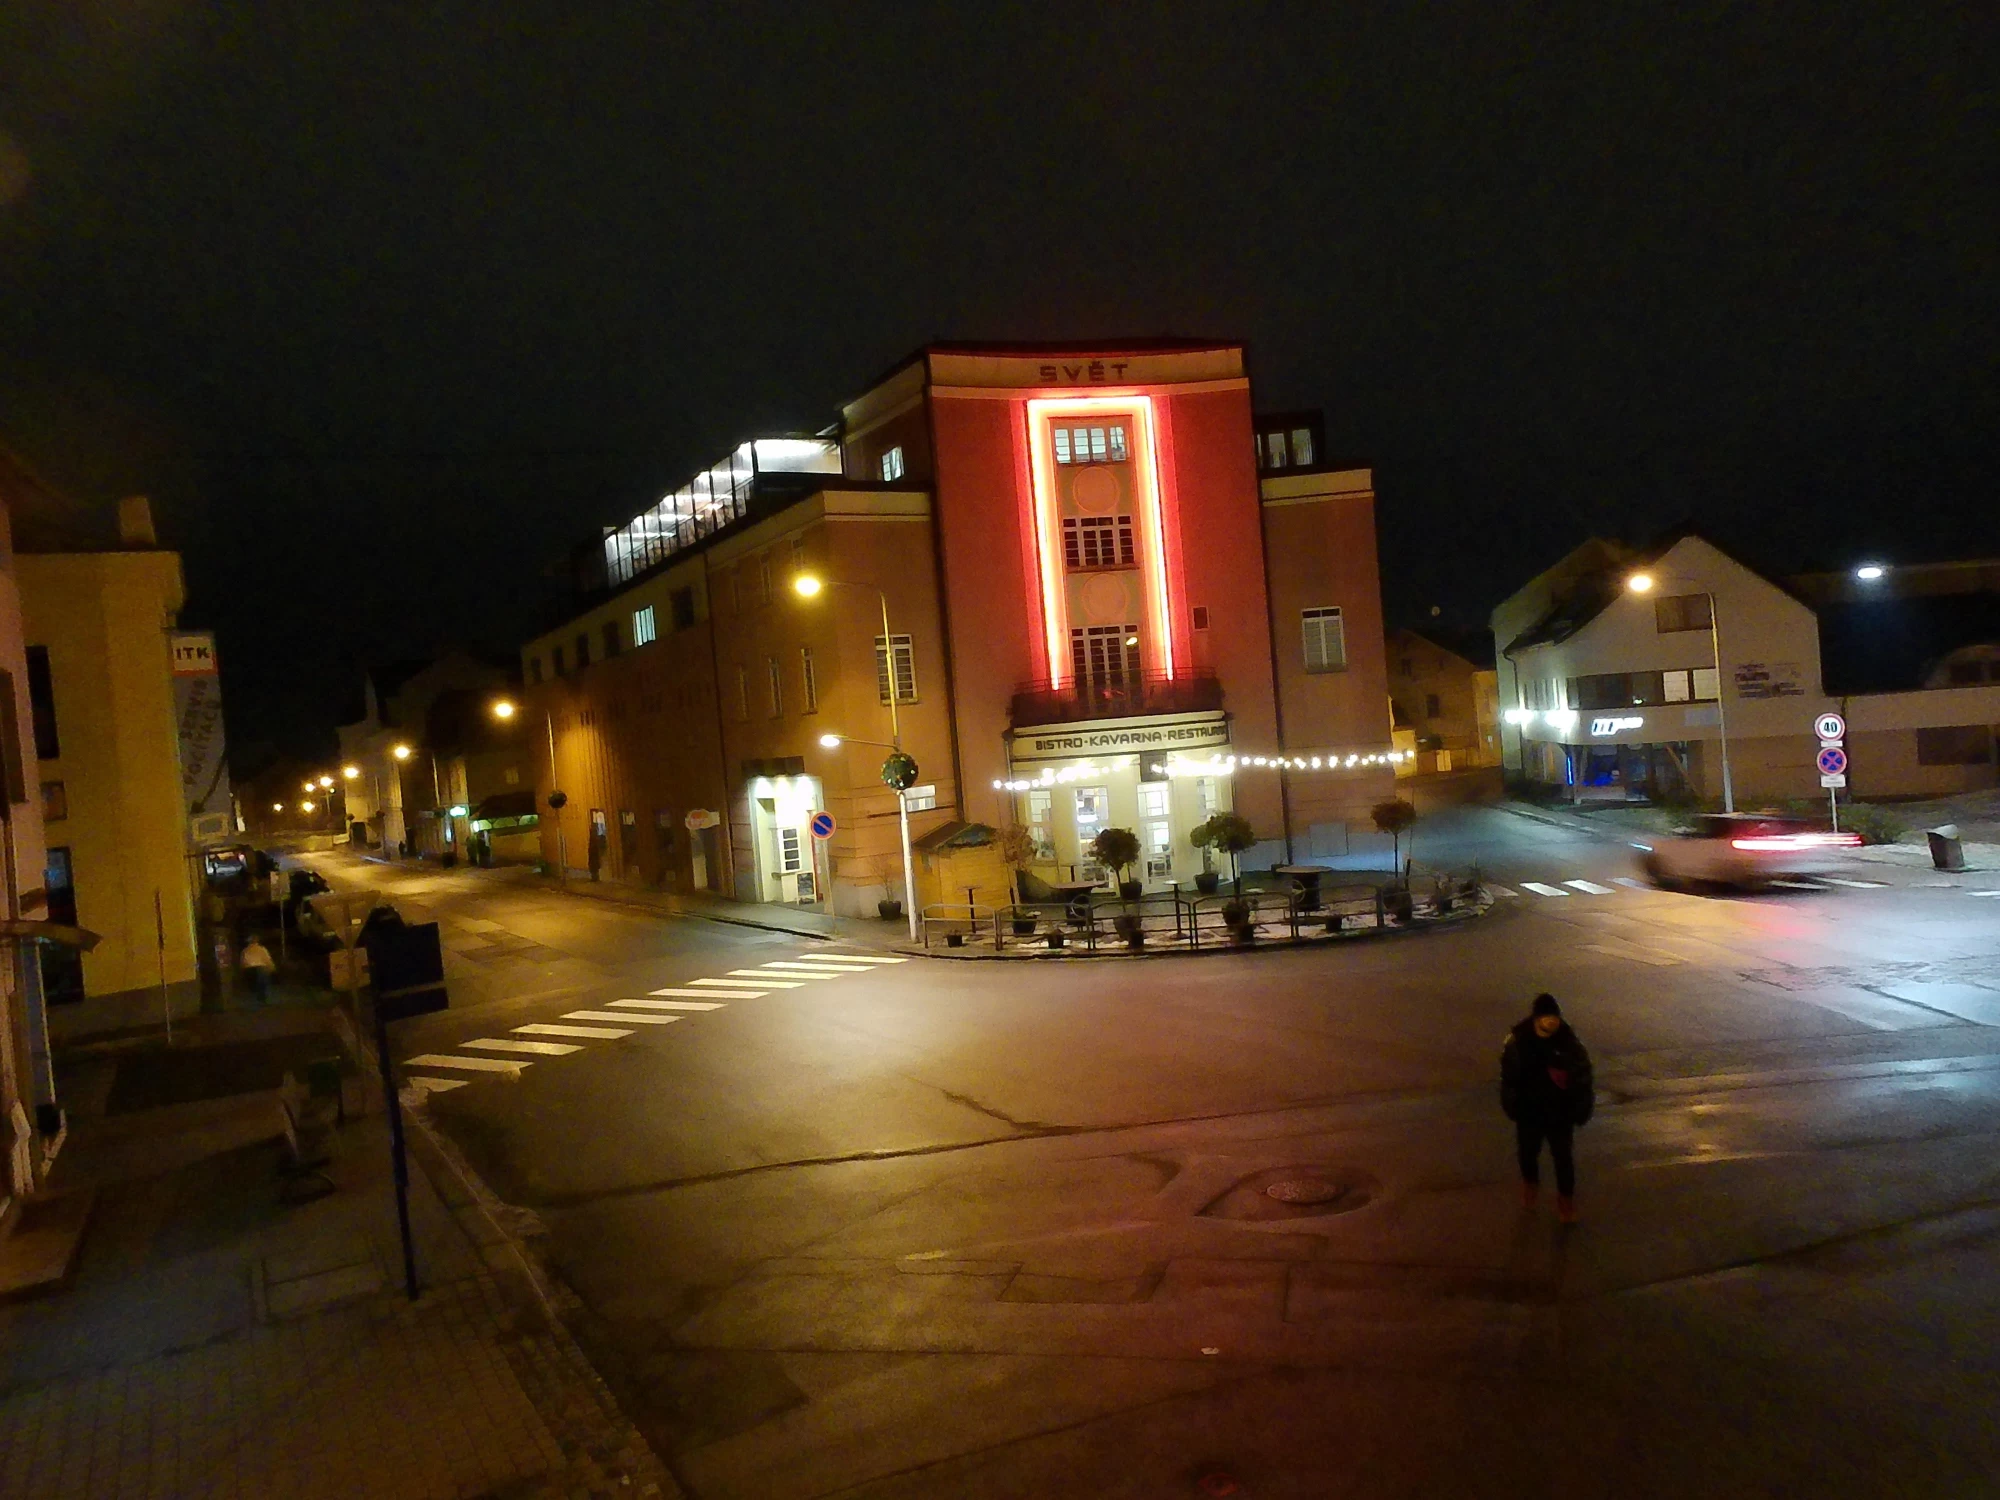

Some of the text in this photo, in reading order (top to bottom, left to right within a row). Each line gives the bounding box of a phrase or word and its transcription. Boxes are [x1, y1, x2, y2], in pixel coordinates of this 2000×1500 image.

[1039, 360, 1128, 382] SVĚT
[175, 647, 210, 660] ITK
[1823, 721, 1838, 733] 40
[1035, 737, 1082, 751] BISTRO
